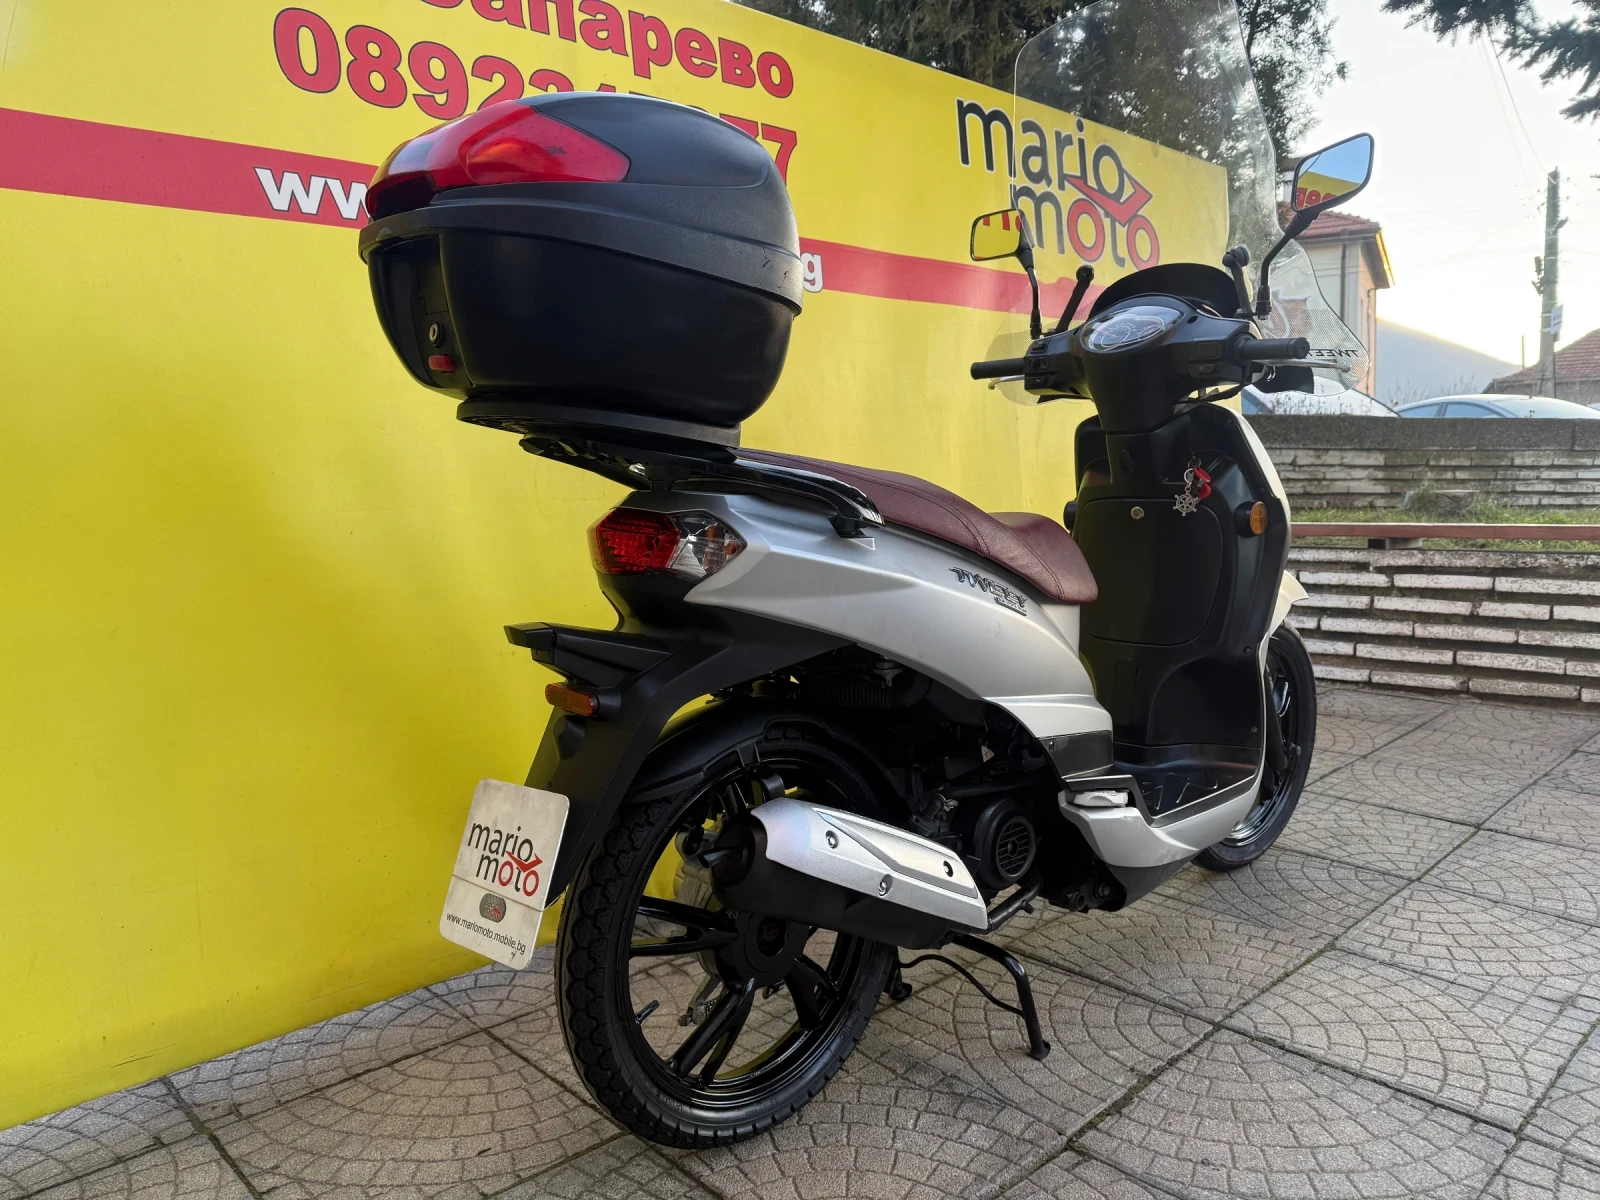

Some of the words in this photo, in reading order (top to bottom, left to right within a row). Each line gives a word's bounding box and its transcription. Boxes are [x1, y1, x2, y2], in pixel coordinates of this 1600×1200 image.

[420, 0, 793, 98] апарево
[956, 98, 1125, 203] mario
[1010, 182, 1161, 271] moto
[467, 822, 534, 862] mario
[475, 851, 540, 897] moto
[446, 912, 527, 956] www.mariomoto.mobile.bg
